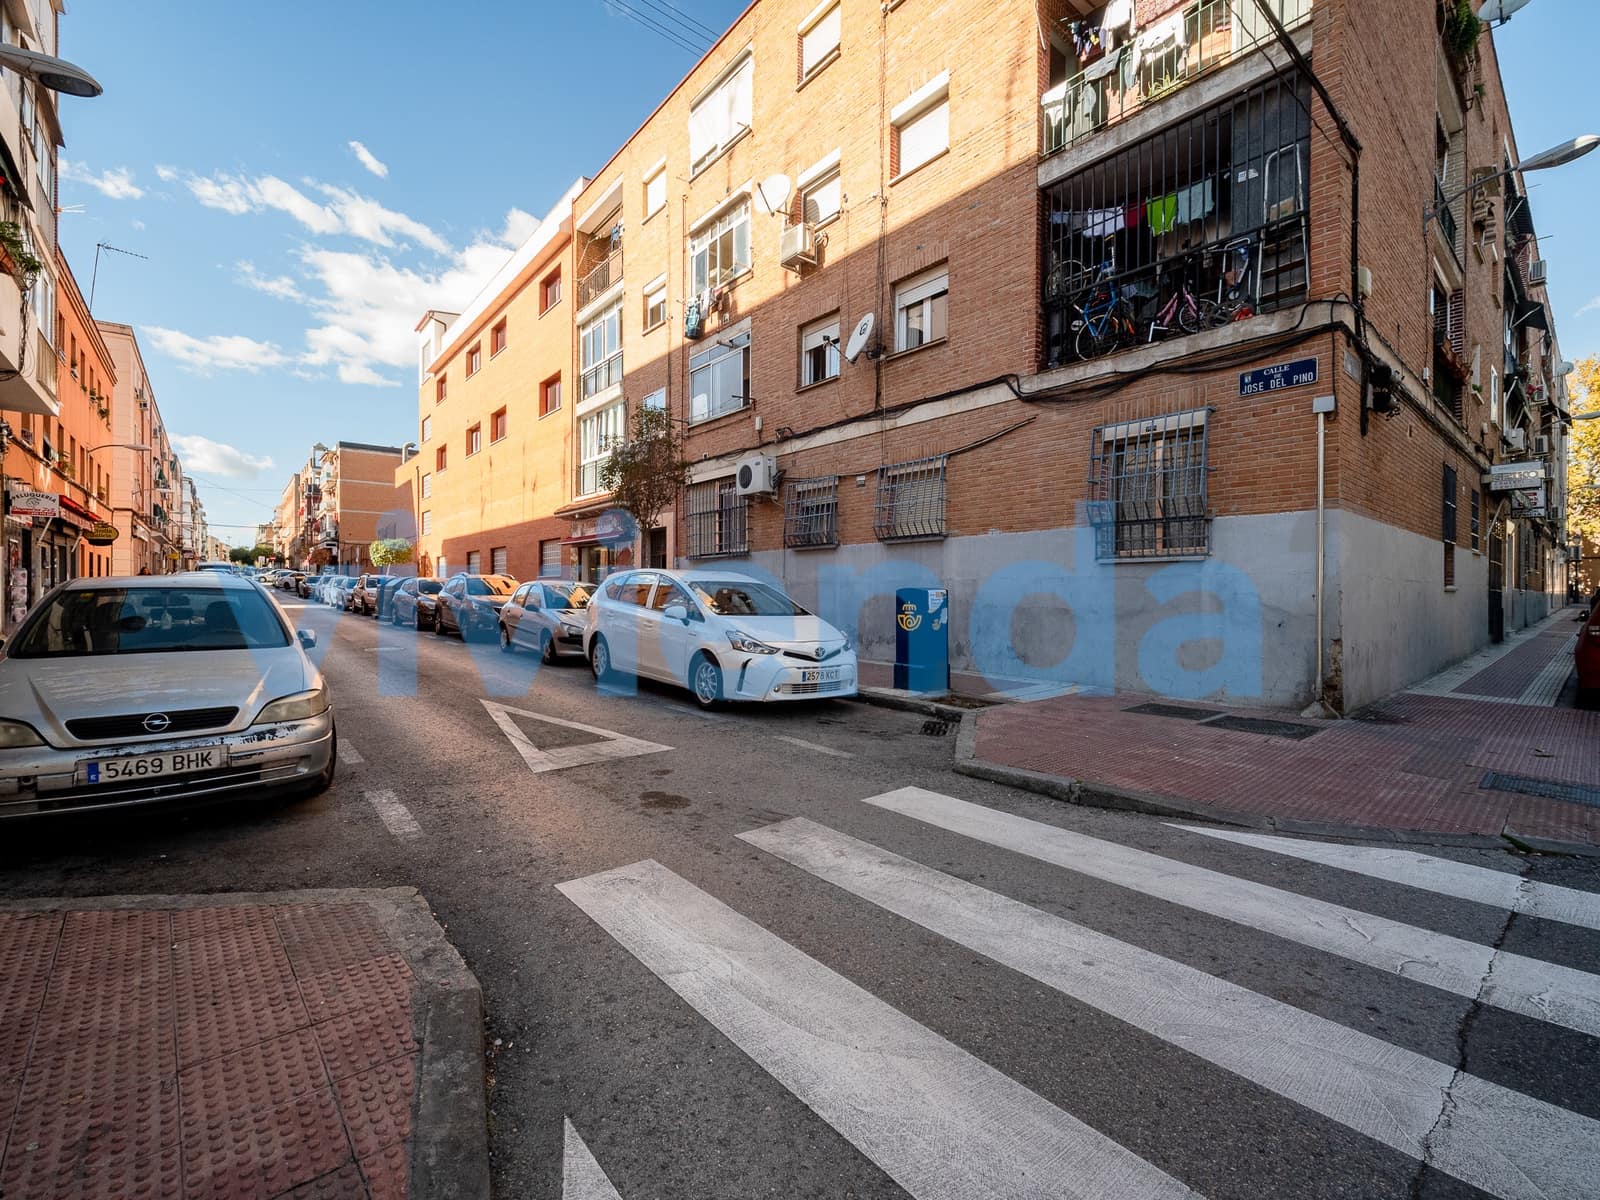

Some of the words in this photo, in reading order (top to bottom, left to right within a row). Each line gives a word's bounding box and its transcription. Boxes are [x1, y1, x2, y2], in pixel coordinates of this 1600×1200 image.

[1263, 364, 1290, 376] CALLE
[1241, 381, 1264, 395] JOSE
[1270, 378, 1286, 389] DEL
[1293, 372, 1314, 384] PINO
[807, 671, 824, 681] 2578
[105, 758, 163, 779] 5469
[172, 751, 212, 771] BHK
